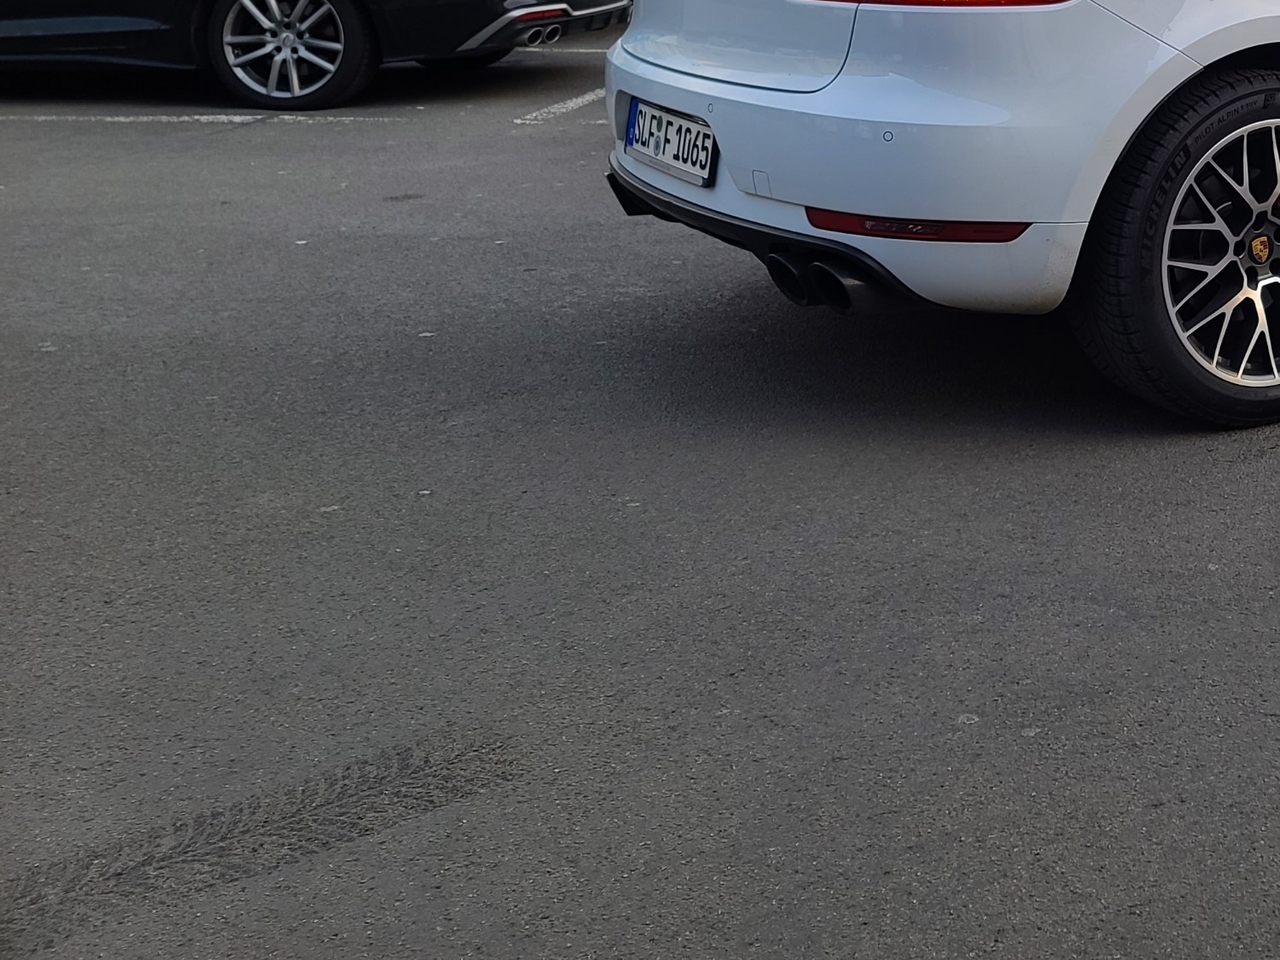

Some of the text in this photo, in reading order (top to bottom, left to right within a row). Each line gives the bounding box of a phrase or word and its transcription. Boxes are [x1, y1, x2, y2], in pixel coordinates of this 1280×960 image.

[634, 108, 711, 171] SLF F 1065
[1194, 122, 1216, 145] PILOT
[1217, 107, 1240, 126] ALPIN
[1140, 148, 1187, 271] MICHELIN
